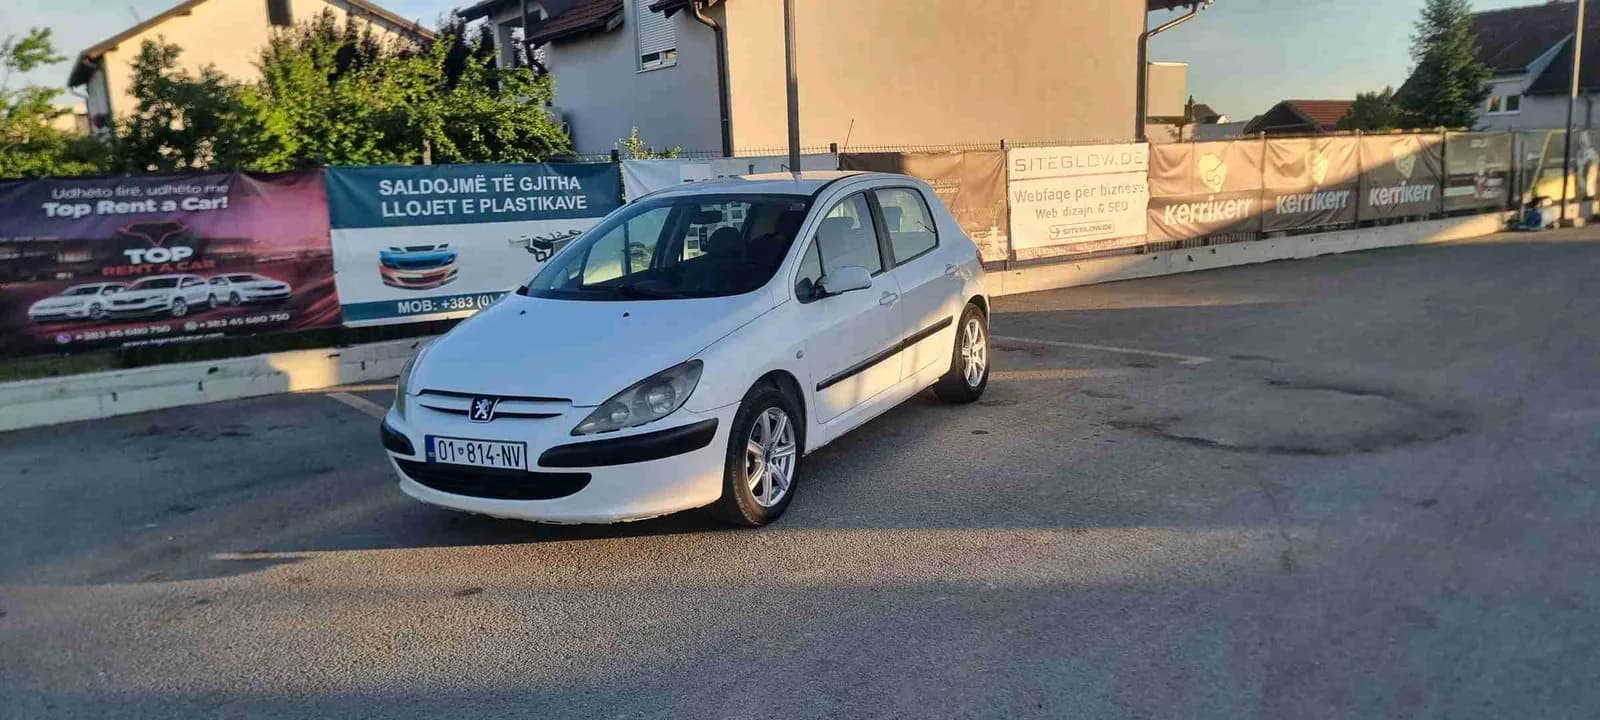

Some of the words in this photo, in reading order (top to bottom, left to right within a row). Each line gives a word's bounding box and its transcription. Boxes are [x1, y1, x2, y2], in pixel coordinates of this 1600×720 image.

[1015, 151, 1143, 172] SITEGLOW.DE
[204, 183, 229, 194] me
[379, 175, 487, 196] SALDOJMË
[491, 173, 515, 193] TË
[519, 175, 582, 192] GJITHA
[1013, 187, 1071, 204] Webfaqe
[1074, 185, 1097, 201] për
[1368, 180, 1435, 207] kerrikerr
[42, 201, 92, 218] Top
[96, 198, 157, 215] Rent
[160, 199, 177, 211] a
[181, 195, 229, 210] Car!
[381, 199, 457, 218] LLOJET
[461, 200, 475, 214] E
[479, 195, 588, 213] PLASTIKAVE
[1035, 207, 1058, 220] Web
[1062, 206, 1093, 218] dizajn
[1097, 202, 1105, 214] &
[1107, 200, 1129, 213] SEO
[1164, 195, 1253, 226] kerrikerr
[1275, 186, 1350, 215] kerrikerr
[123, 246, 194, 264] TOP
[101, 263, 152, 276] RENT
[159, 263, 174, 272] A
[176, 260, 216, 271] CAR
[397, 299, 438, 314] MOB:
[441, 296, 474, 310] +383
[229, 317, 244, 326] 45
[269, 313, 290, 322] 750
[438, 440, 455, 462] 01
